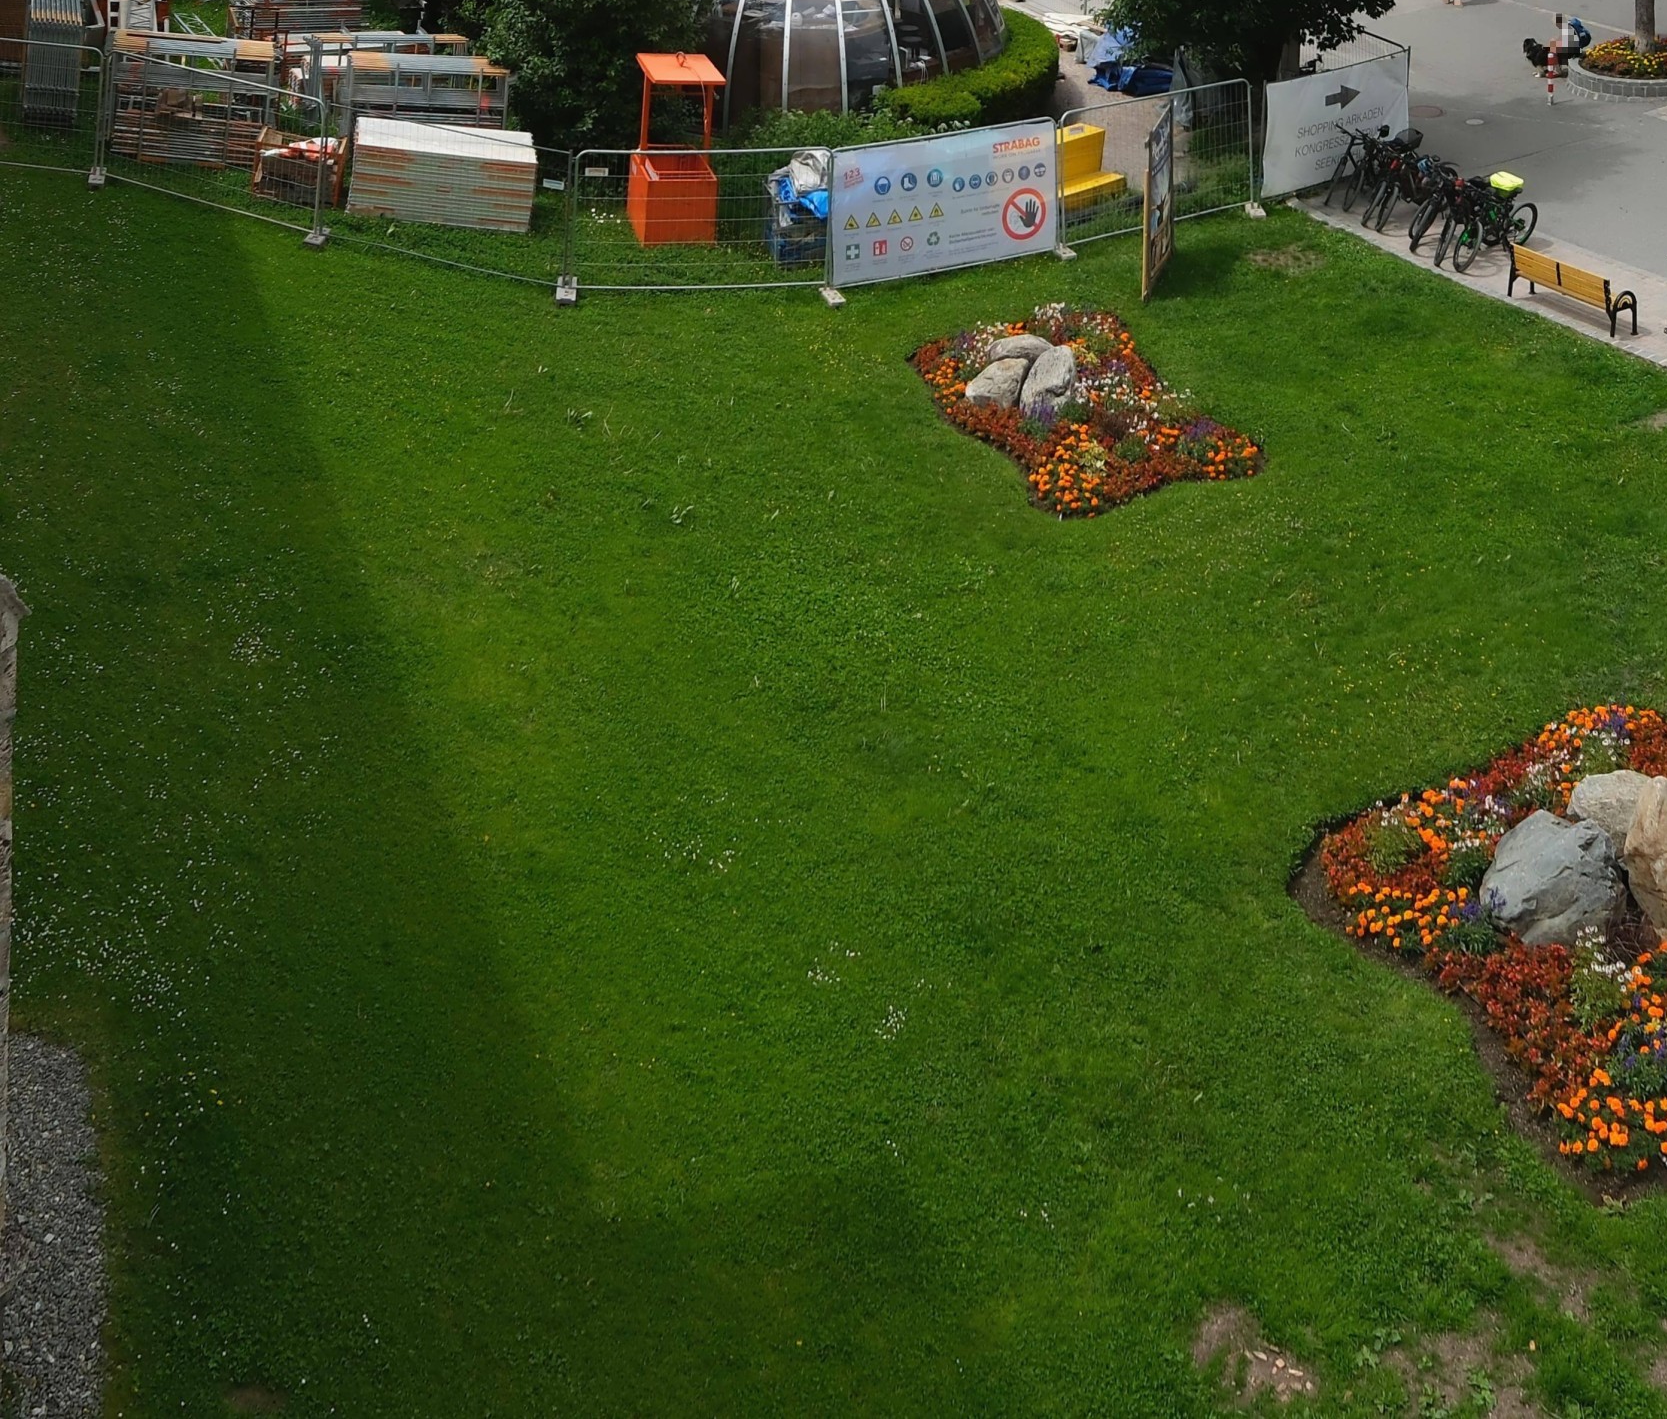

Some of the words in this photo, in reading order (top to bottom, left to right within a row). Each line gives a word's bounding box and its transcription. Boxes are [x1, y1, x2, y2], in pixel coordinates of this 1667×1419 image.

[1297, 118, 1344, 139] SHOPPING
[1346, 107, 1384, 125] ARKADEN
[992, 137, 1041, 154] STRABAG
